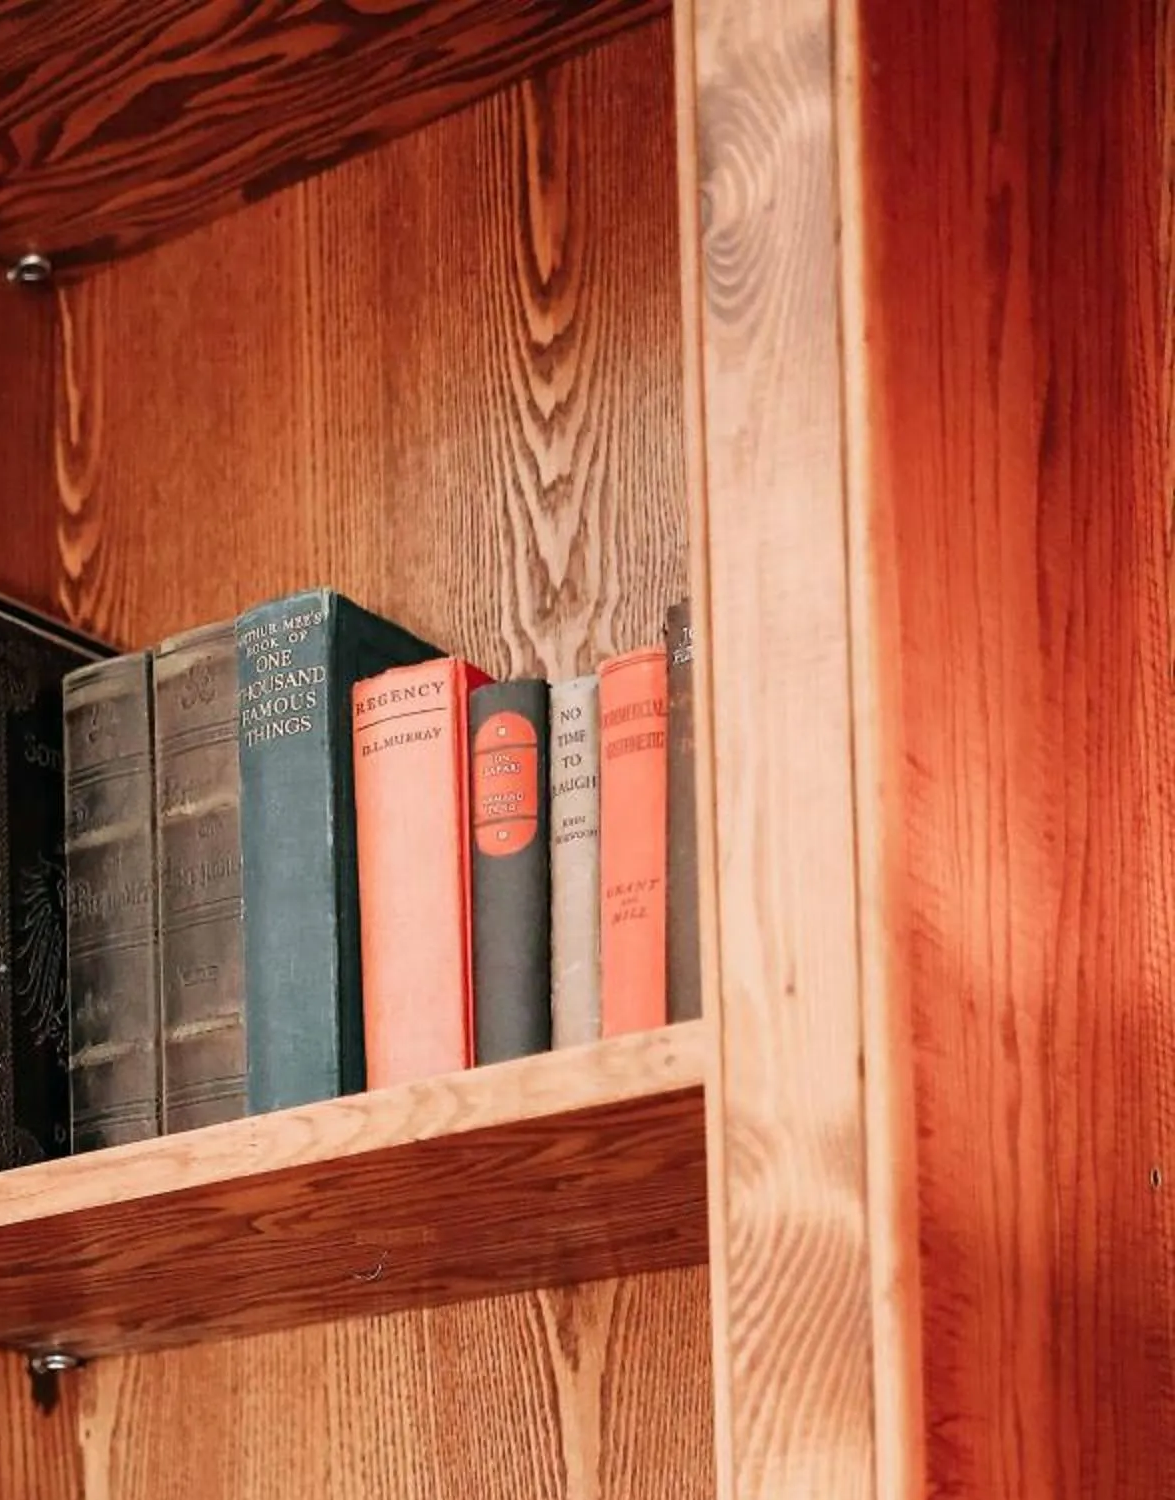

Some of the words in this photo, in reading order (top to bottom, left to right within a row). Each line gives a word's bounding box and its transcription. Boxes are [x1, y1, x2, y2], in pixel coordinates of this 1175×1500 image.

[288, 631, 308, 644] OF
[256, 649, 292, 673] ONE
[242, 691, 317, 728] FAMOUS
[355, 681, 445, 716] REGENCY
[560, 706, 582, 724] NO
[245, 715, 312, 748] THINGS
[557, 729, 586, 748] TIME
[561, 753, 582, 769] TO
[552, 775, 598, 799] LAUGH
